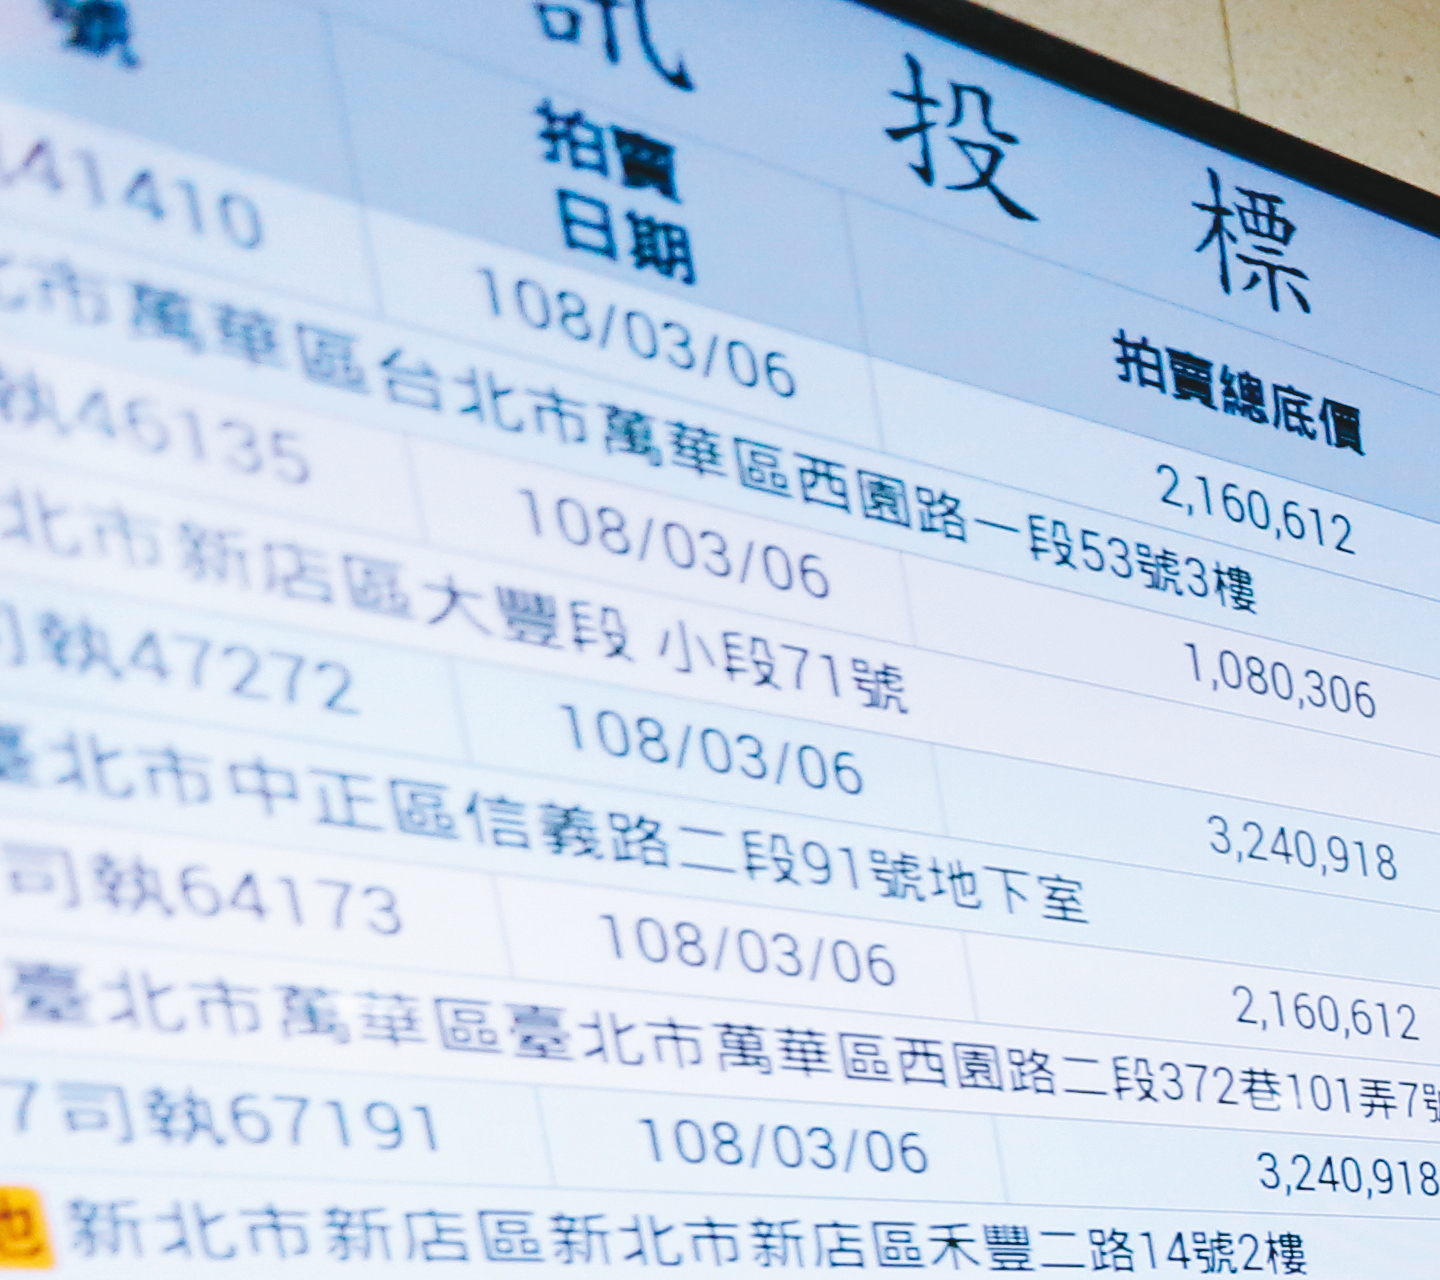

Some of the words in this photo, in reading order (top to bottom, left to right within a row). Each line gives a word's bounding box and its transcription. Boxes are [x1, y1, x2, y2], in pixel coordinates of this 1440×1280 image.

[534, 98, 682, 204] 拍賣
[557, 188, 696, 286] 日期
[478, 266, 797, 399] 108/03/06
[1156, 463, 1356, 557] 2,160,612
[1110, 328, 1366, 457] 拍賣總底價
[521, 488, 830, 601] 108/03/06
[1183, 642, 1377, 723] 1,080,306
[657, 620, 910, 714] 小段71號
[558, 704, 864, 797] 108/03/06
[1206, 814, 1400, 885] 3,240,918
[2, 840, 403, 938] 司執64173
[598, 911, 896, 988] 108/03/06
[1232, 984, 1421, 1044] 2,160,612
[638, 1115, 931, 1176] 108/03/06
[66, 1196, 1308, 1278] 新北市新店區新北市新店區禾豐二路14號2樓
